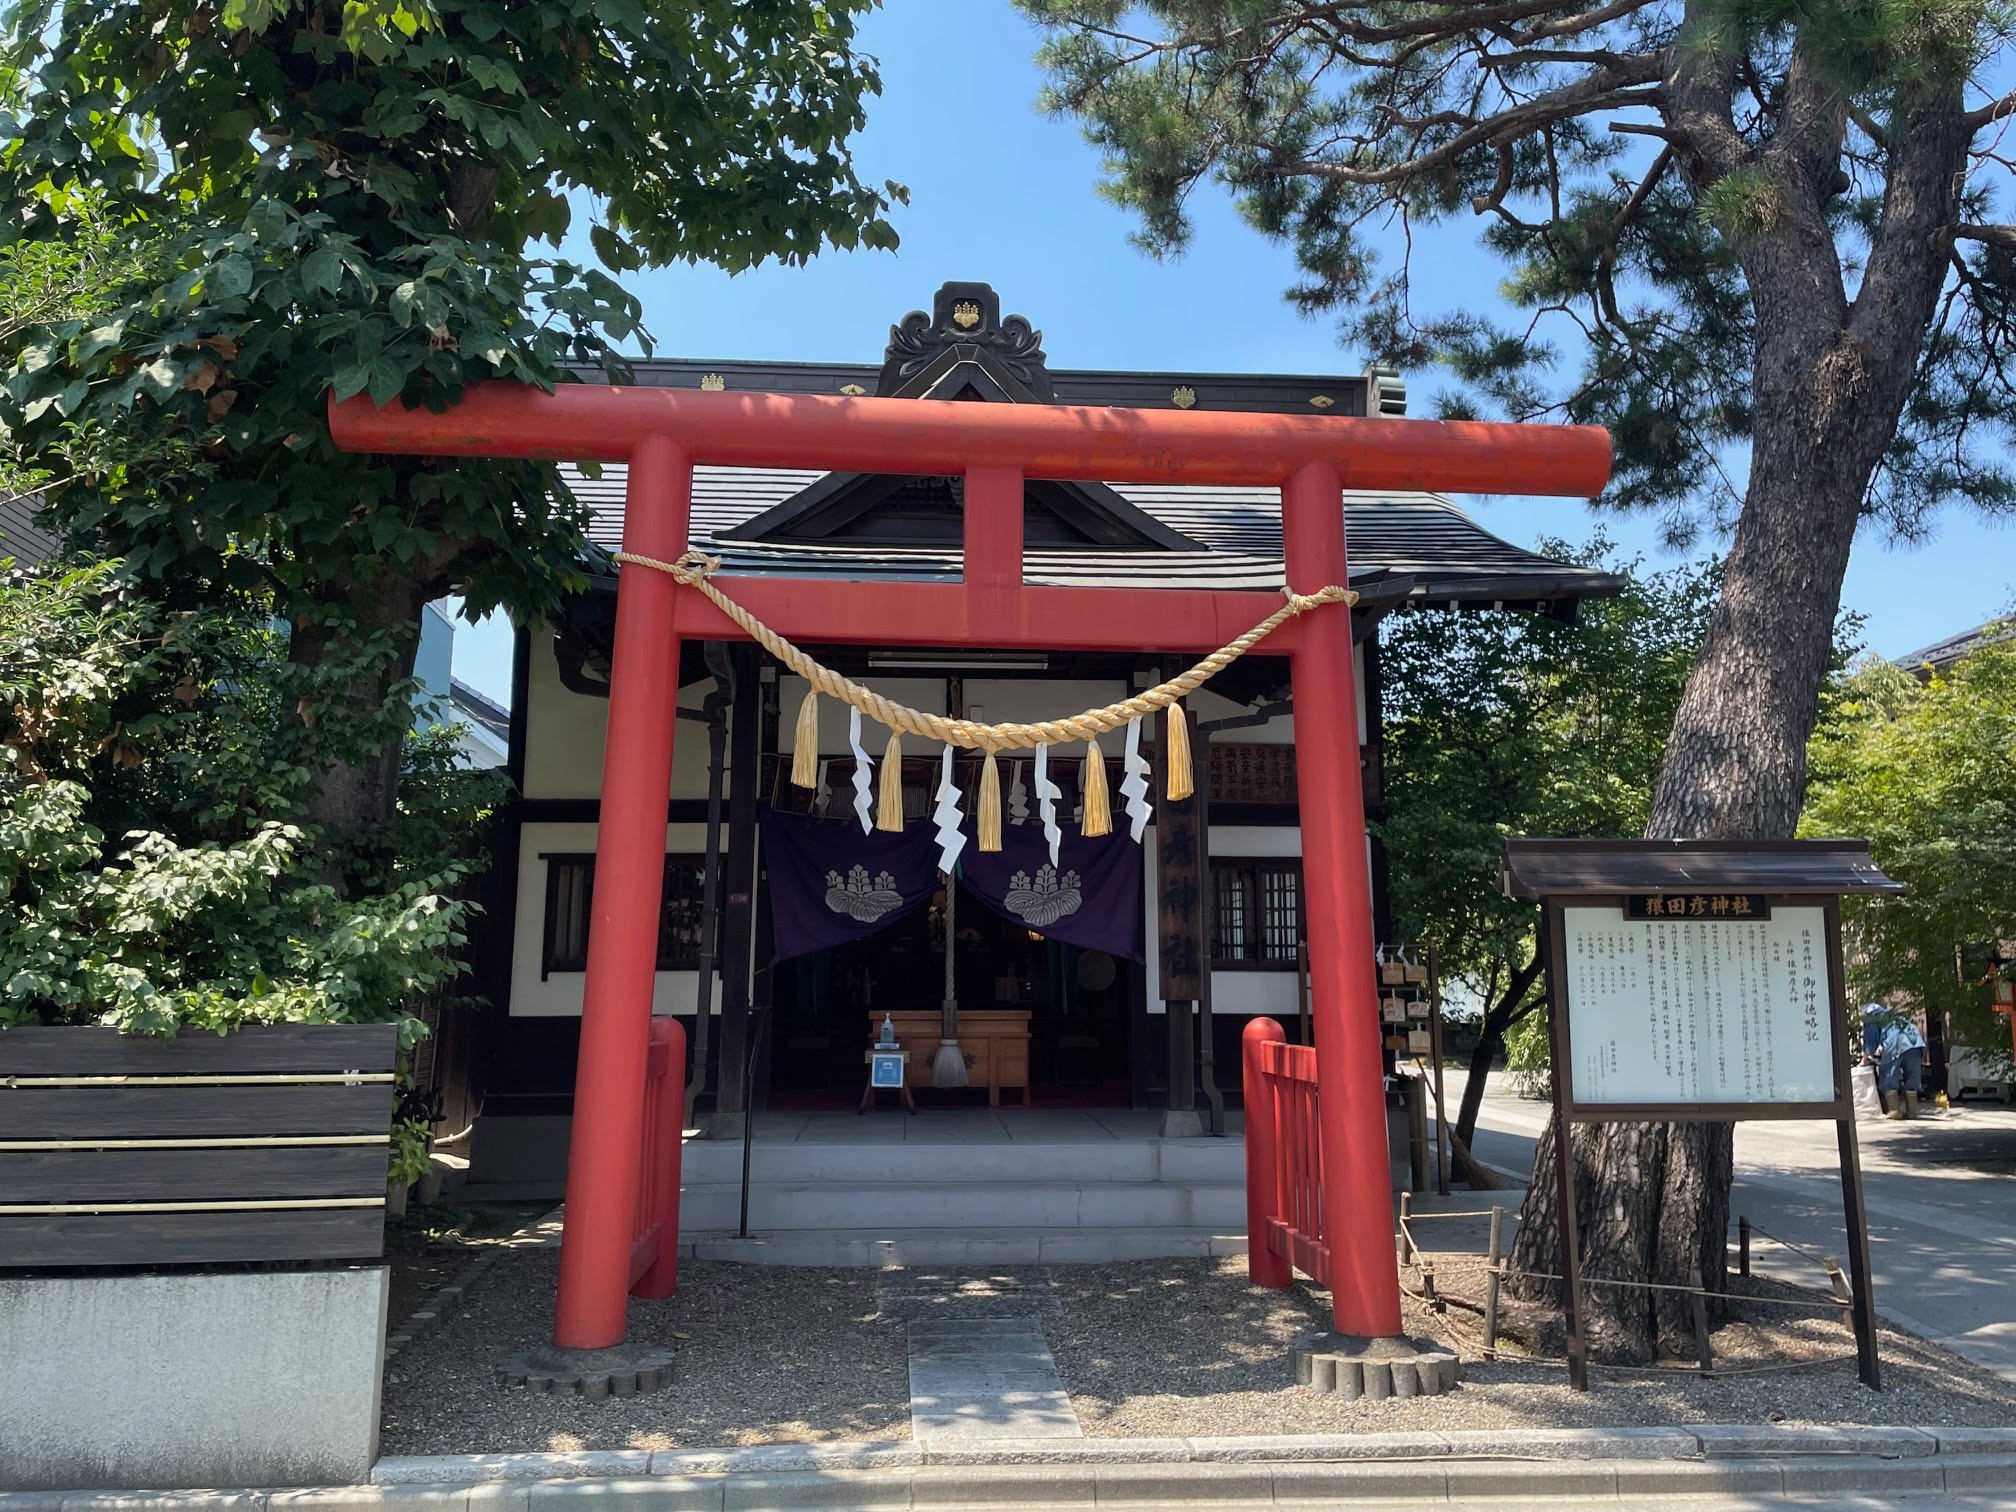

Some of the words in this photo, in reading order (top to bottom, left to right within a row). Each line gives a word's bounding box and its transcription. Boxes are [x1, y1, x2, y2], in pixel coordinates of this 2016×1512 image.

[1646, 896, 1752, 915] 猿田彦神社
[1803, 977, 1818, 1041] 御神徳略記
